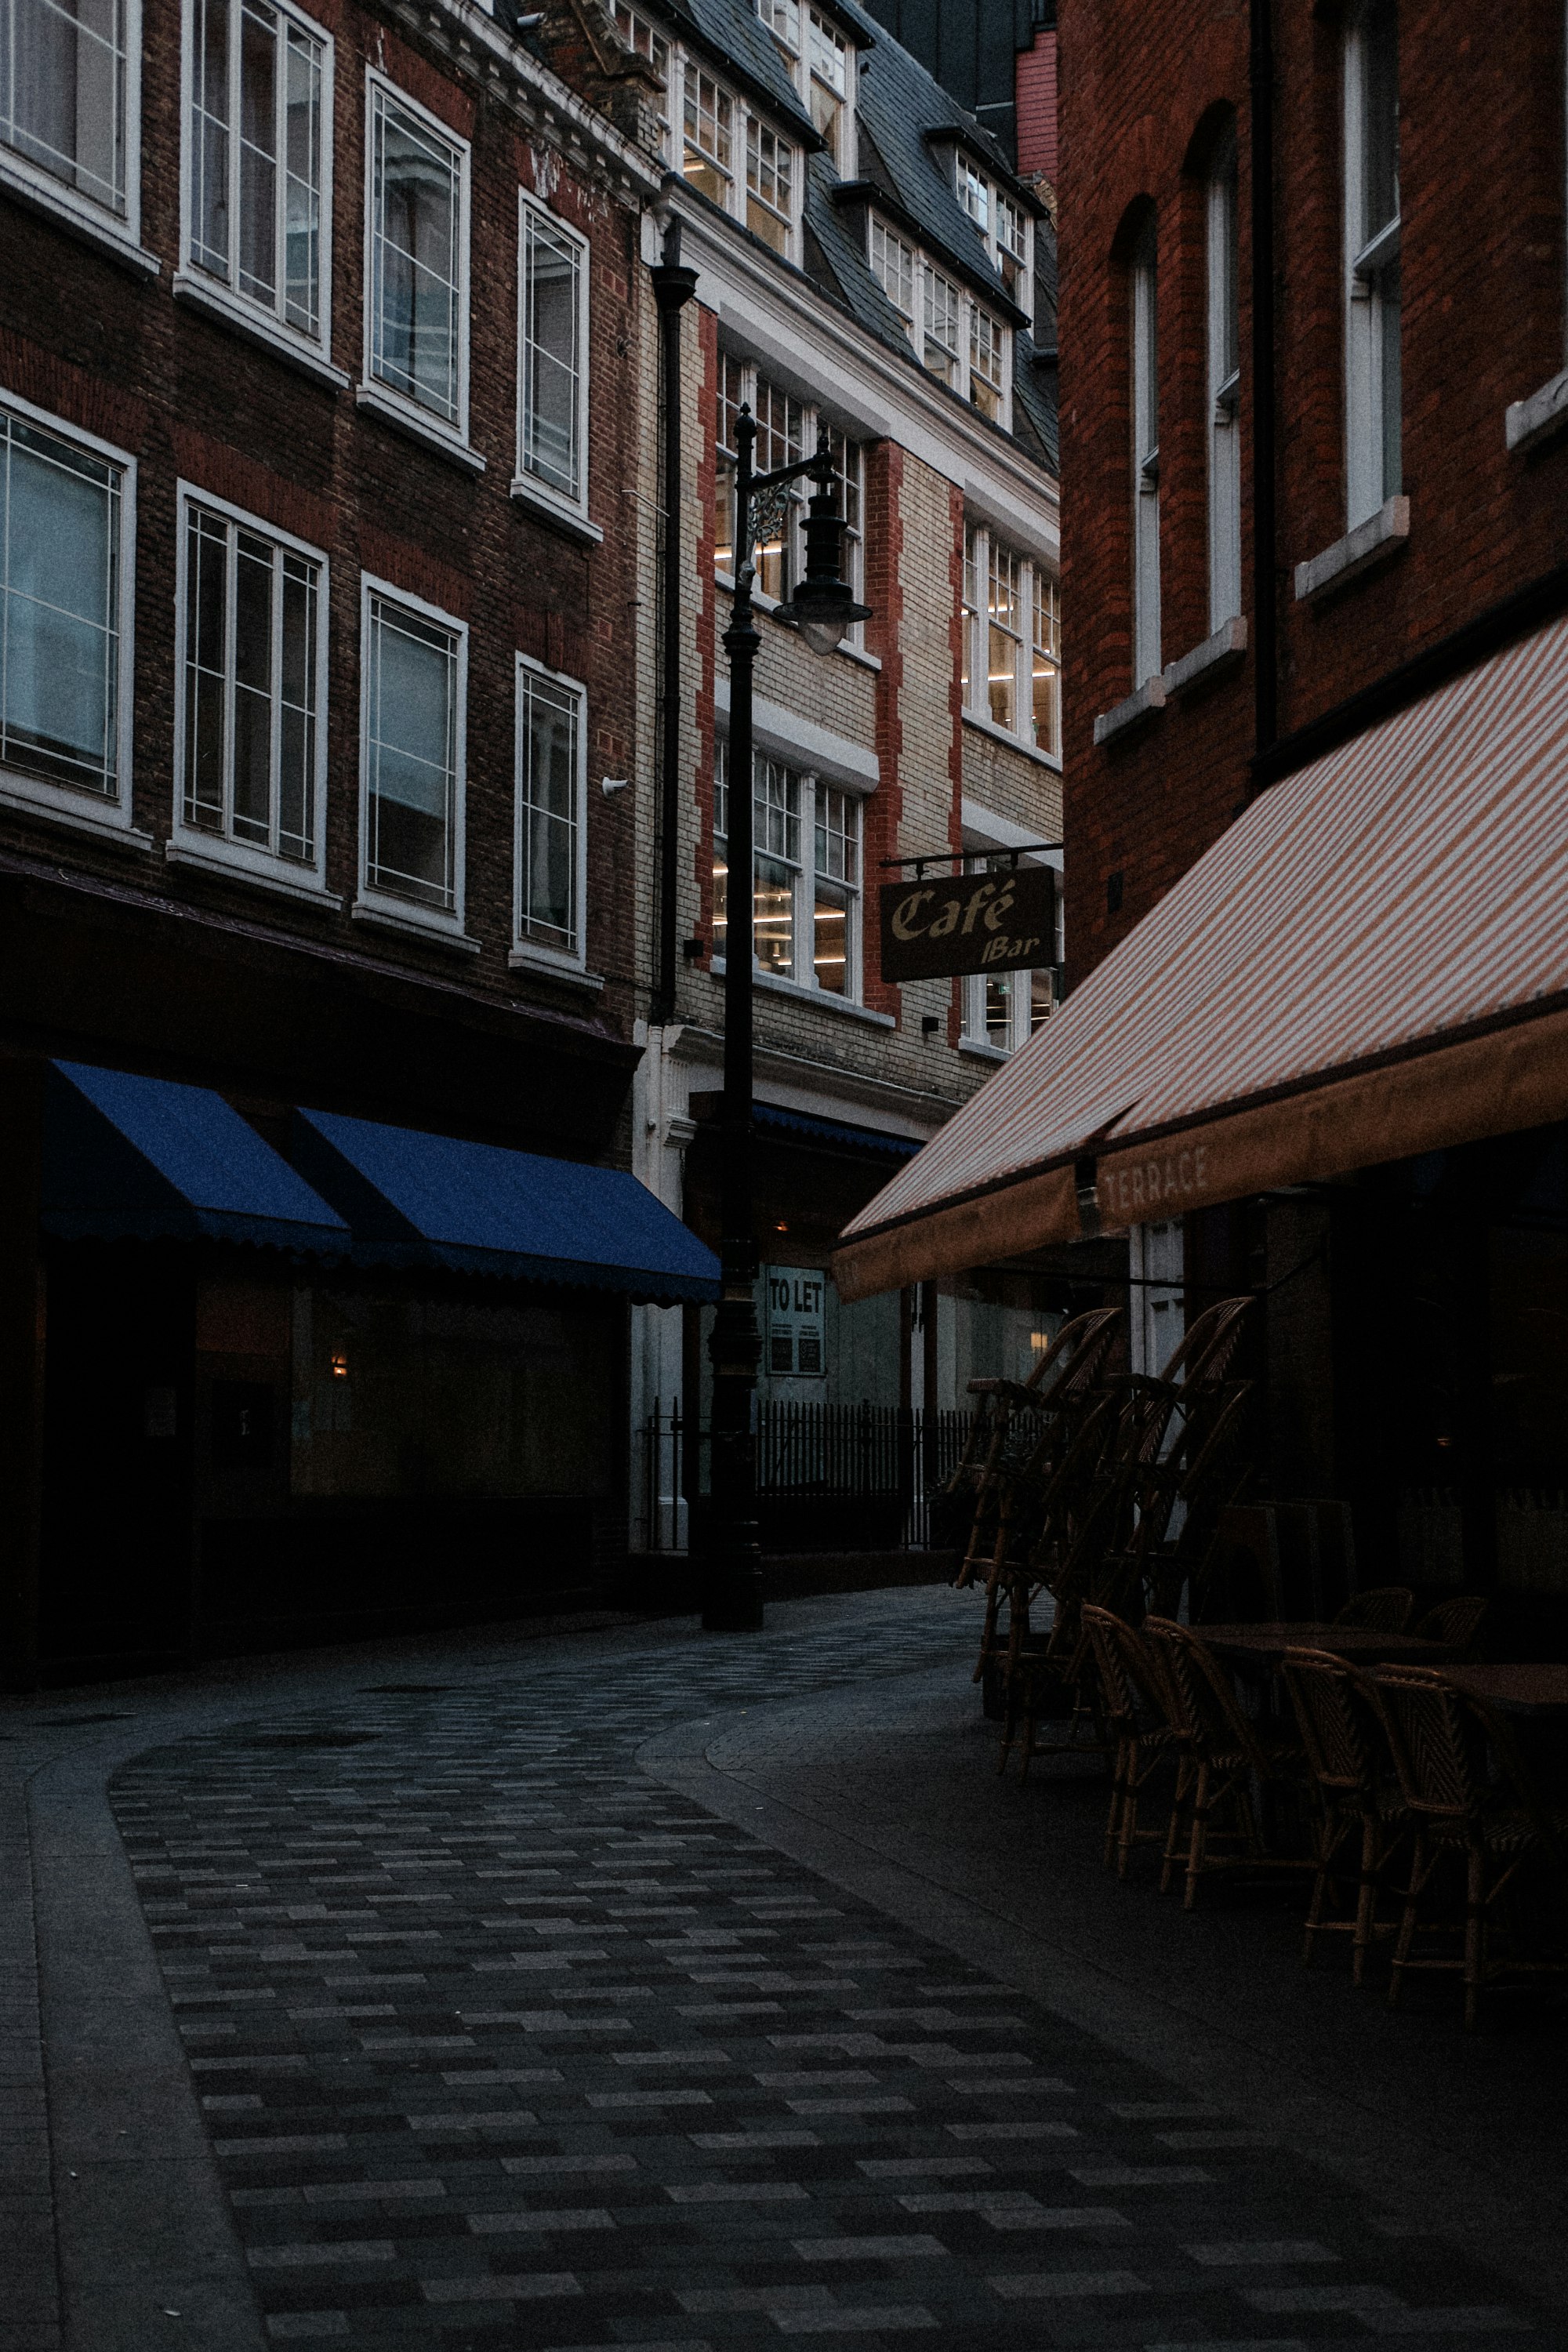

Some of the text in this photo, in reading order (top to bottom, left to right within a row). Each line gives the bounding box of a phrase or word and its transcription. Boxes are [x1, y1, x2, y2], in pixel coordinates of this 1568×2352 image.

[891, 879, 1016, 941] Café
[980, 935, 1040, 964] Bar
[1104, 1146, 1207, 1213] TERRACE
[769, 1278, 822, 1313] TO LET
